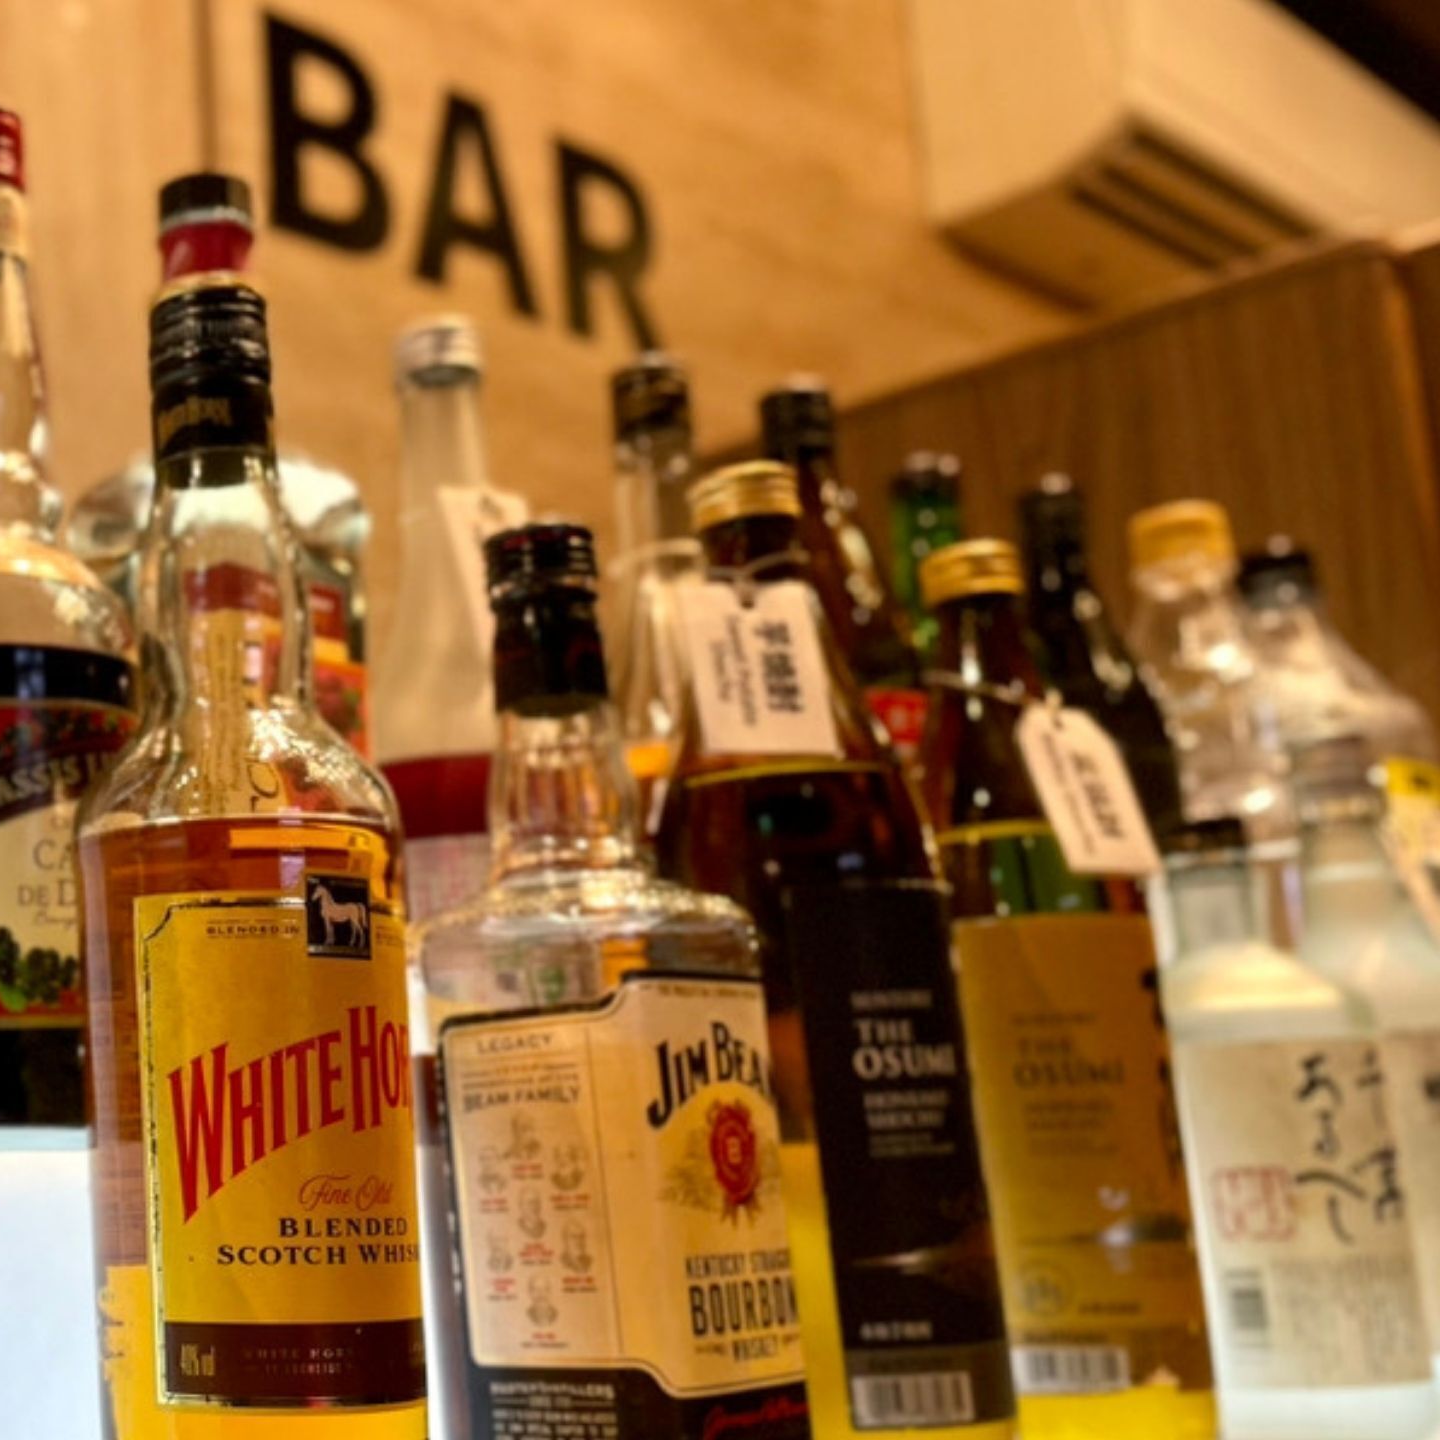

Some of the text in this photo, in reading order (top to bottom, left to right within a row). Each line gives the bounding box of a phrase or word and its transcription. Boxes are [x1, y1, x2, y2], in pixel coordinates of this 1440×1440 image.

[263, 10, 666, 352] BAR
[648, 1041, 710, 1129] JIM
[167, 1030, 344, 1226] WHITE
[299, 1174, 351, 1212] Fine
[217, 1244, 347, 1266] SCOTCH
[279, 1217, 407, 1239] BLENDED
